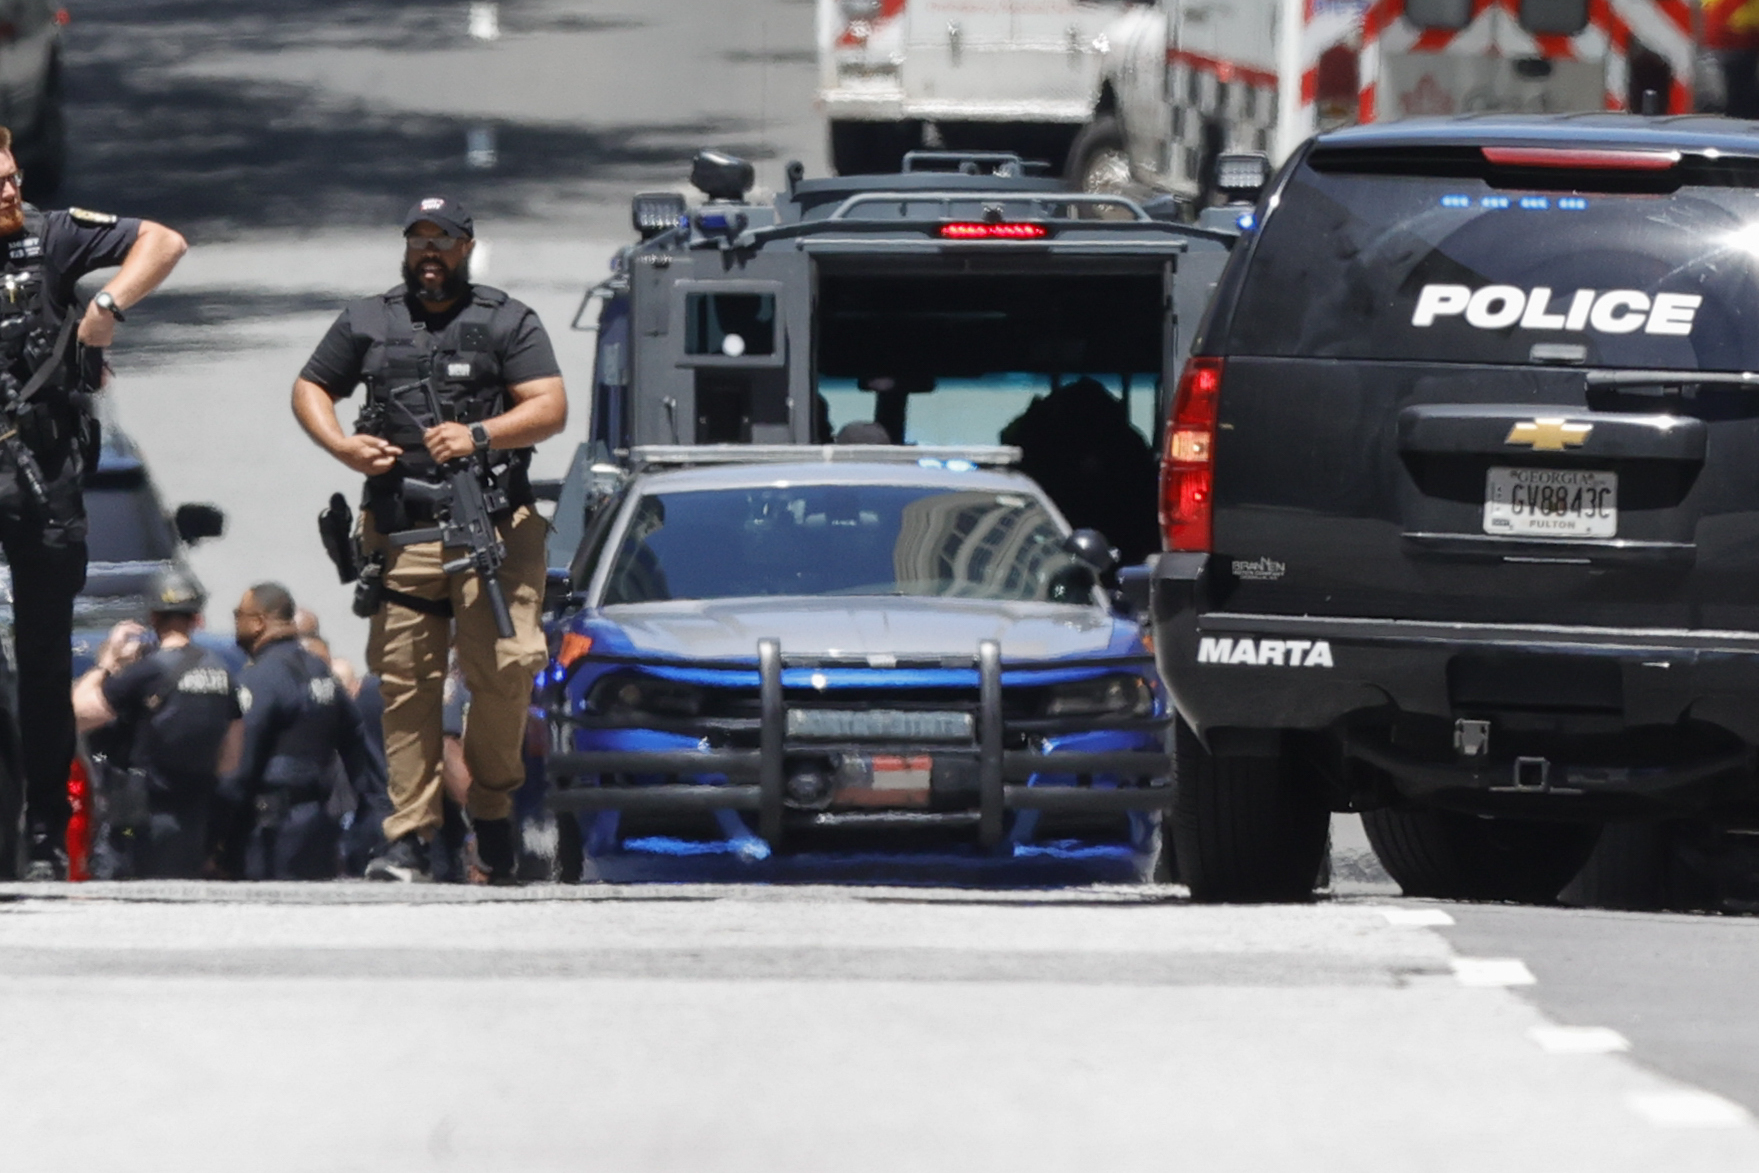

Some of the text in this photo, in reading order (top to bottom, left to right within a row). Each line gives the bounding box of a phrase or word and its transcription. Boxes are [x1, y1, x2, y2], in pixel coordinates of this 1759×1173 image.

[1411, 284, 1703, 336] POLICE
[1517, 470, 1590, 486] GEORGIA
[1512, 484, 1612, 519] GV8843C
[1529, 519, 1576, 530] FULTON
[1197, 637, 1334, 668] MARTA
